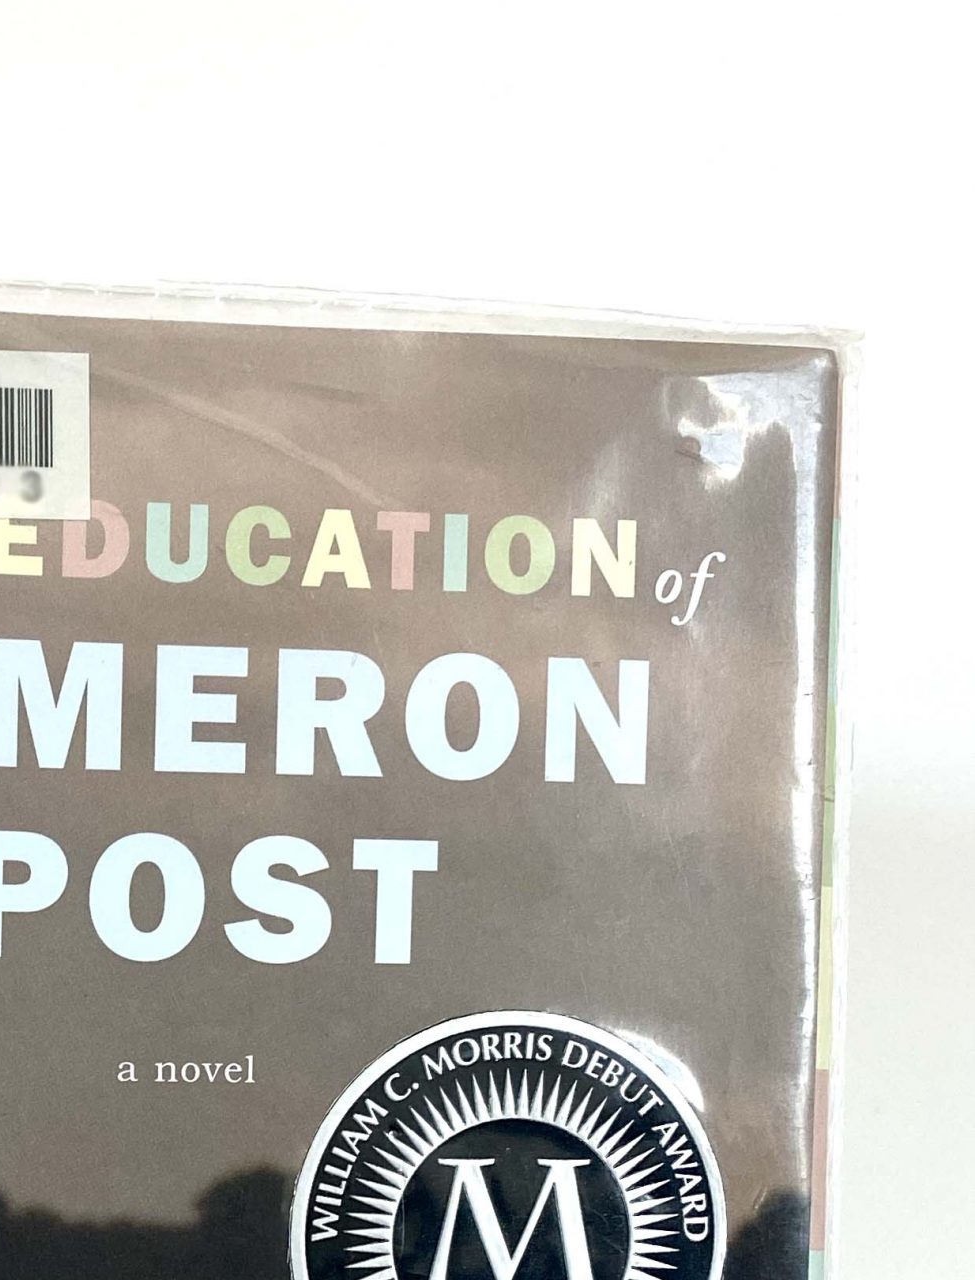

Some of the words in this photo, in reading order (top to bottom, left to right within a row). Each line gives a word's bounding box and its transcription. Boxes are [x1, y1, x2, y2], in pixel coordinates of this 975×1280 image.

[20, 470, 44, 503] 3
[654, 551, 727, 627] of
[117, 1061, 138, 1083] a
[154, 1054, 256, 1084] novel
[310, 1097, 390, 1242] WILLIAM
[383, 1071, 420, 1103] C.
[420, 1031, 555, 1082] MORRIS
[561, 1039, 665, 1117] DEBUT
[651, 1120, 710, 1243] AWARD
